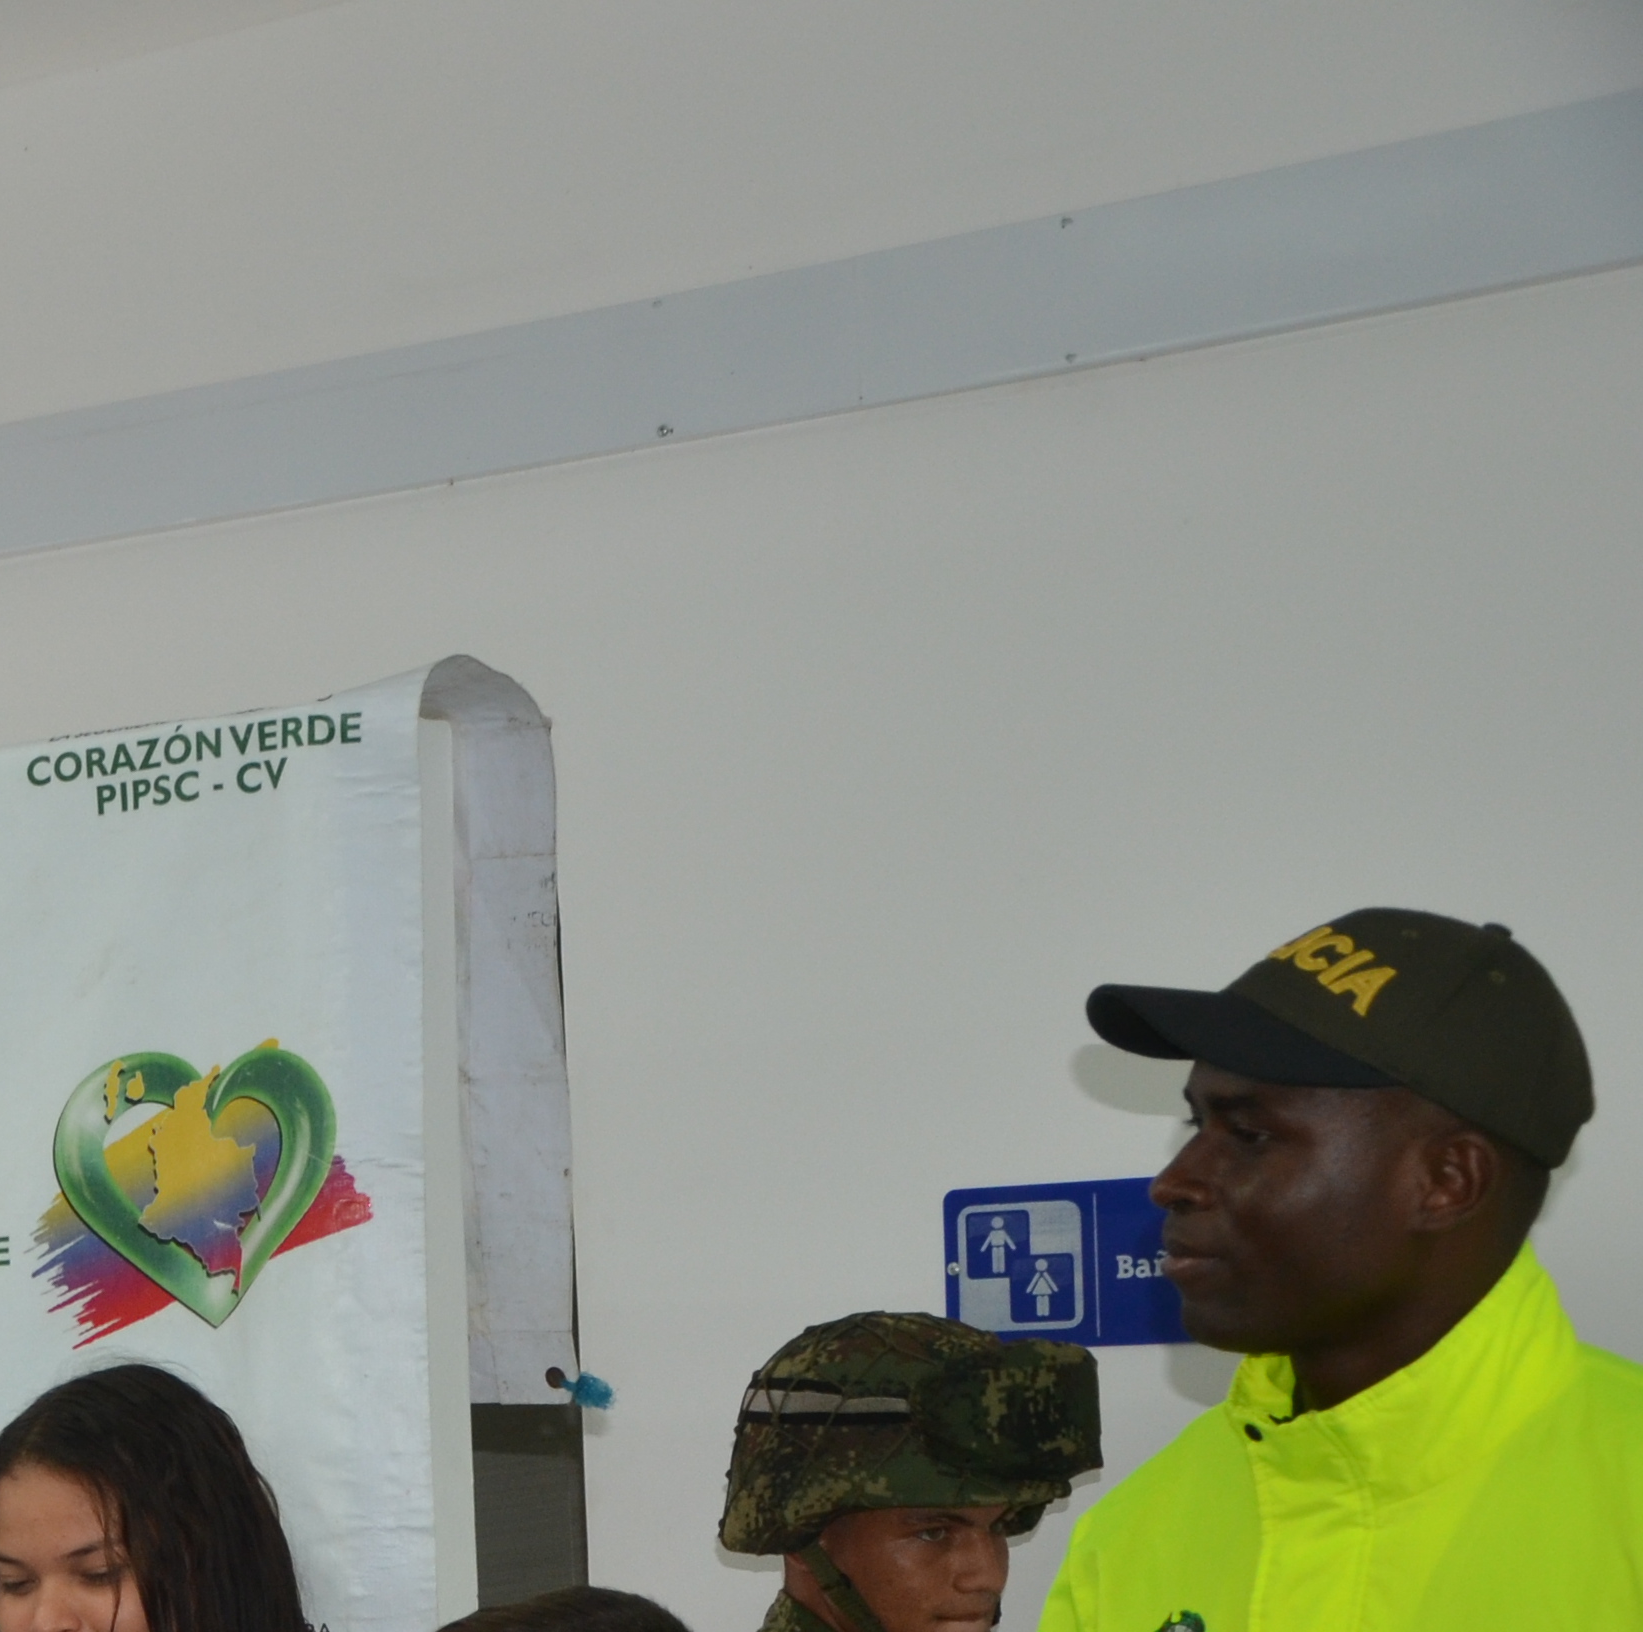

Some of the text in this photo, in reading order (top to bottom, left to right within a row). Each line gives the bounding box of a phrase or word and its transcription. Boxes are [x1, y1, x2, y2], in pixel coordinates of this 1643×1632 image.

[26, 724, 221, 787] CORAZÓN
[229, 712, 362, 755] VERDE
[96, 771, 200, 815] PIPSC
[236, 757, 288, 794] CV
[1269, 926, 1396, 1016] ICIA
